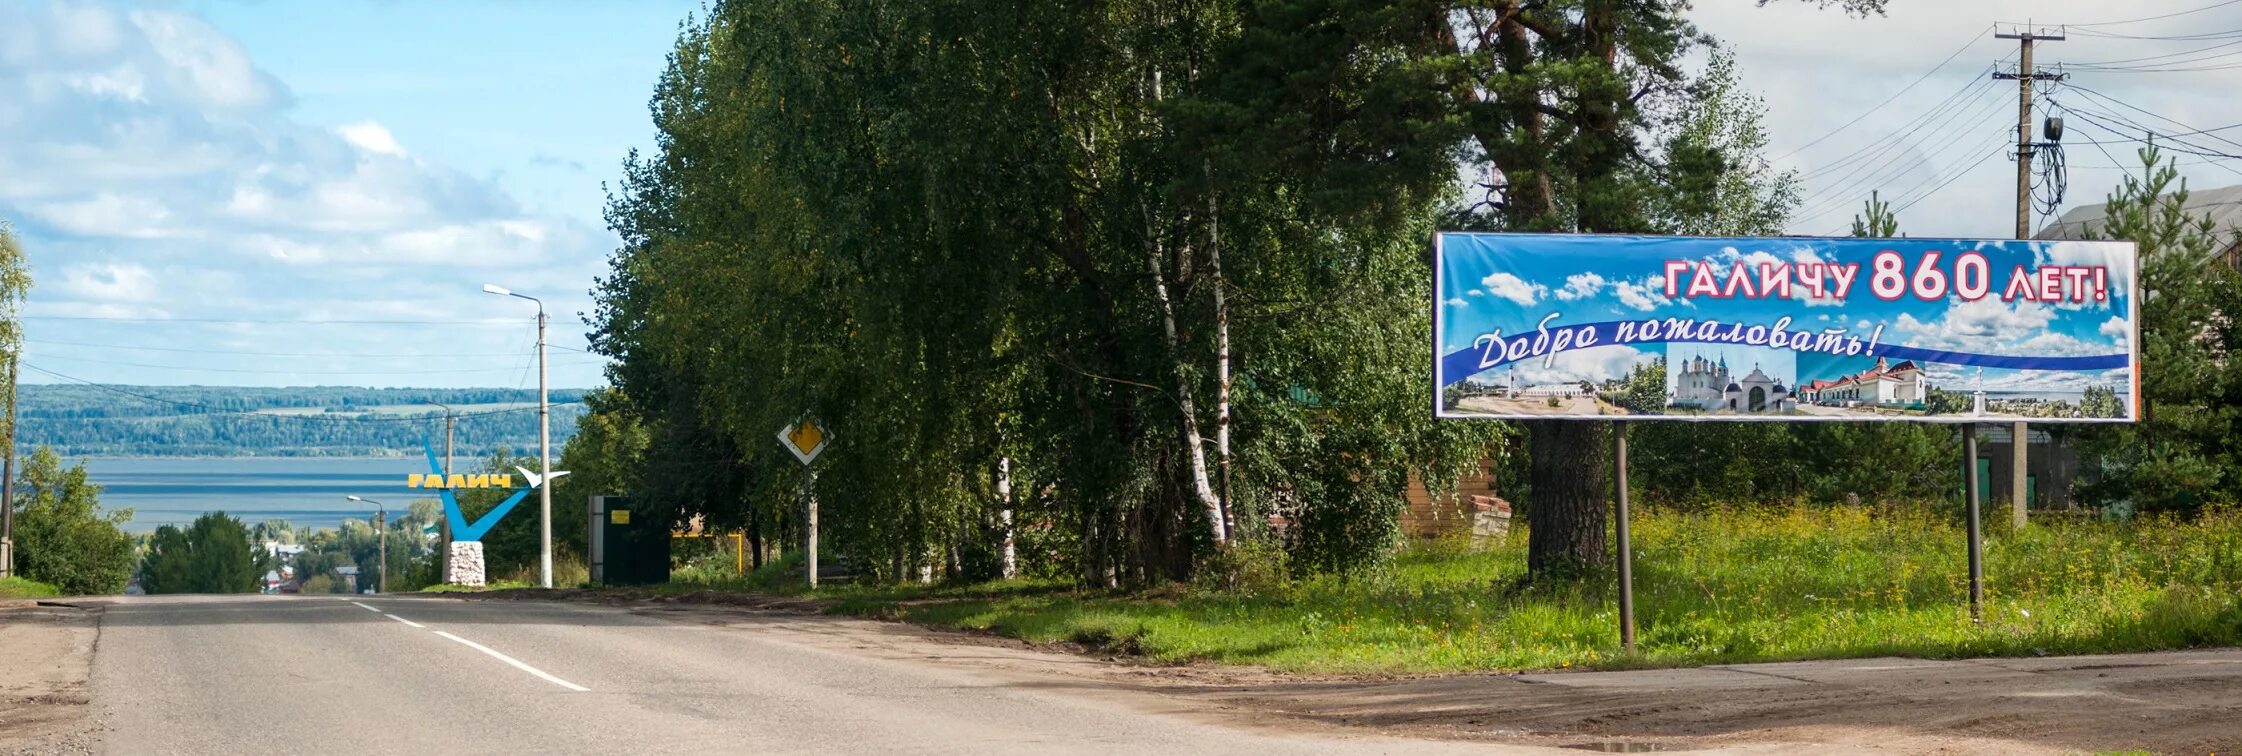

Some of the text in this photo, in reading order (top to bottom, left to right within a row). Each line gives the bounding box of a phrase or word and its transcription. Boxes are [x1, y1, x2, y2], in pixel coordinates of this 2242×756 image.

[1664, 250, 2106, 303] ГАЛИЧУ 860 ЛЕТ!
[1474, 312, 1883, 369] Добро пожаловать!
[408, 474, 511, 488] ГАЛИЧ
